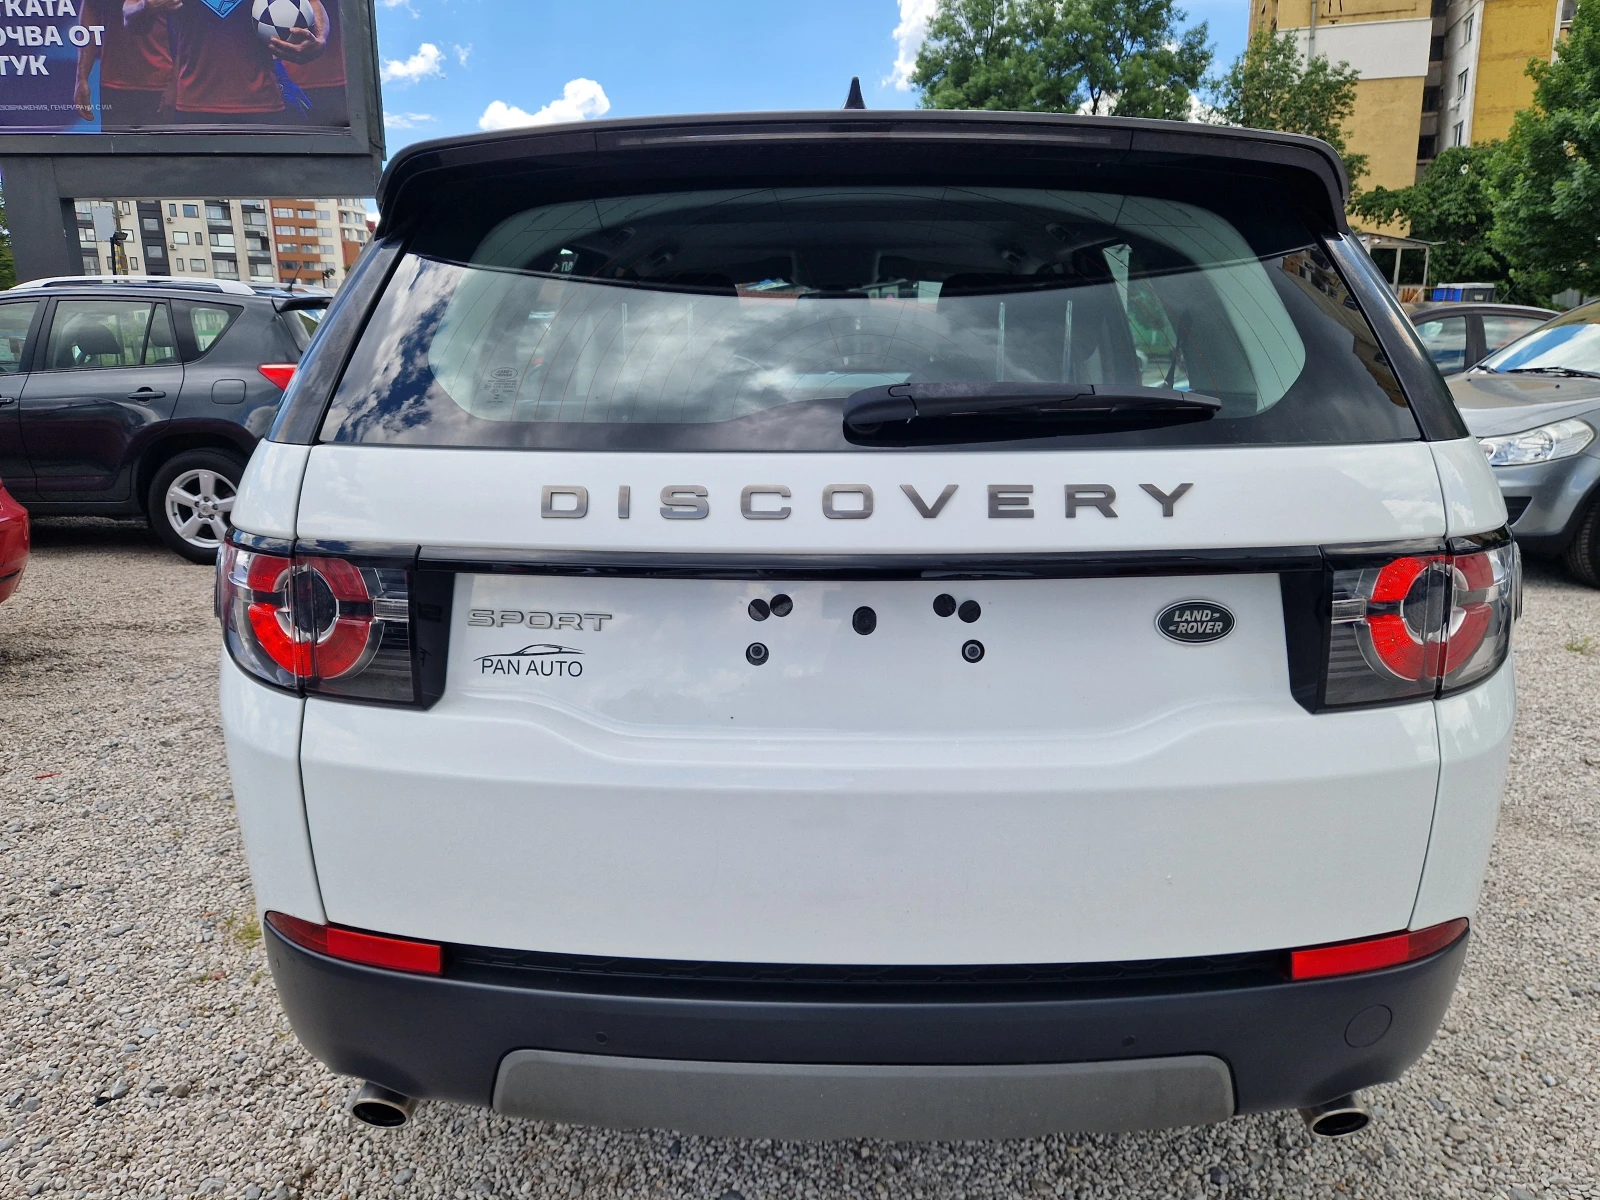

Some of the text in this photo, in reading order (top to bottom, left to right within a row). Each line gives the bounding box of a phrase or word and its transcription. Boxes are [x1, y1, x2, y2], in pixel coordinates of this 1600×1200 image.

[0, 0, 77, 17] КАТА
[68, 25, 105, 47] ОТ
[0, 55, 50, 76] ТУК
[541, 483, 1194, 519] DISCOVERY
[467, 609, 613, 632] SPORT
[1173, 610, 1212, 622] LAND
[1177, 621, 1224, 634] ROVER
[481, 658, 583, 677] PAN AUTO
